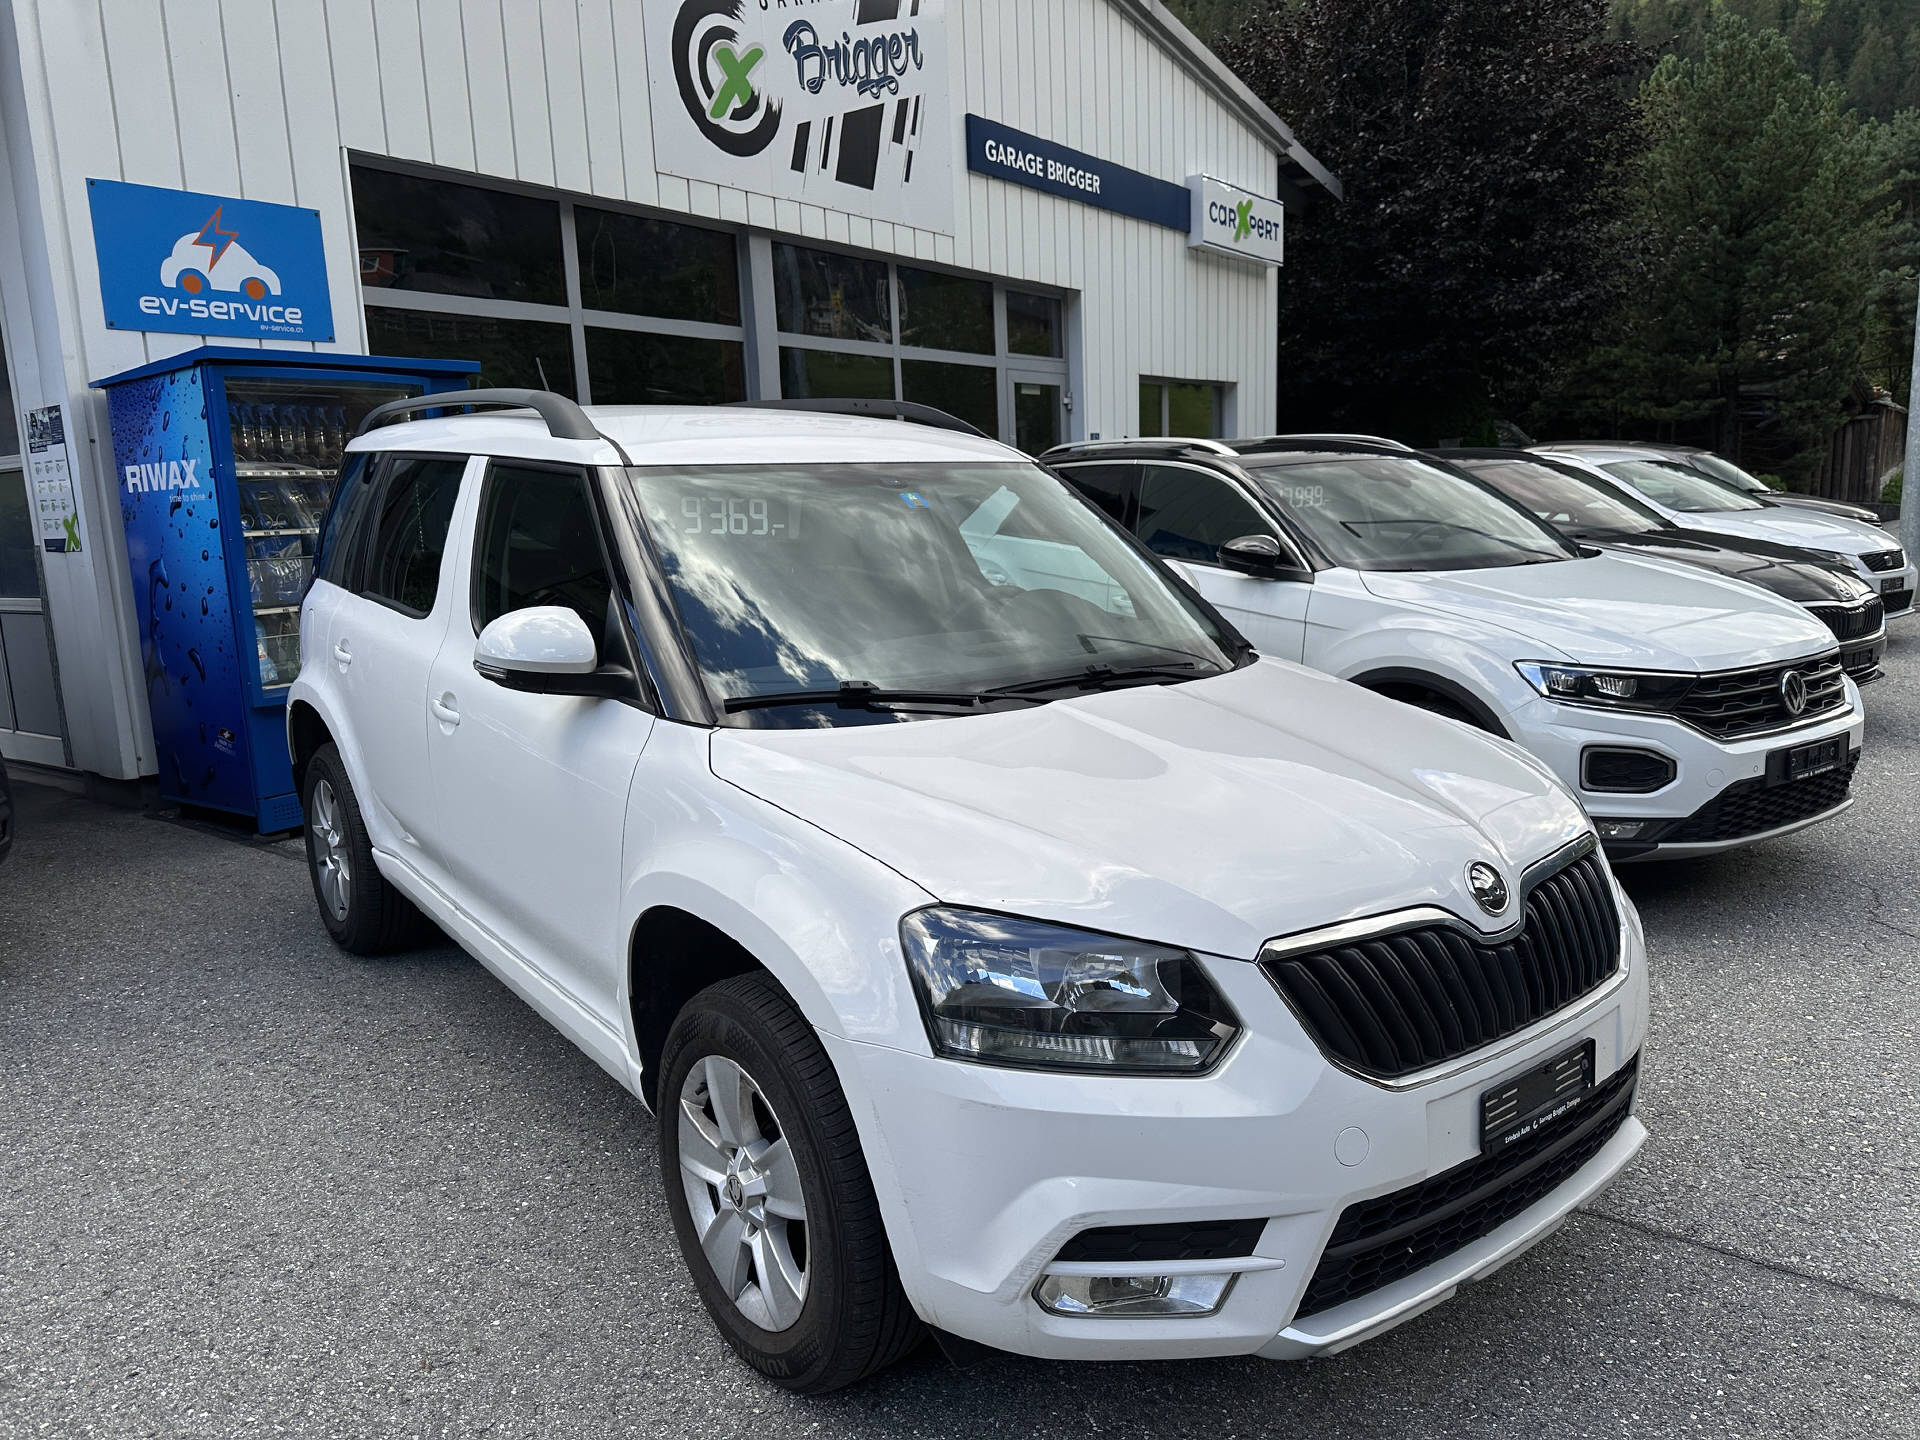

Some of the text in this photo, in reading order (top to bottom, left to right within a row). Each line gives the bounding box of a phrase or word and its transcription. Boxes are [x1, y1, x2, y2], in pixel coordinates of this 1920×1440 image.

[783, 19, 923, 98] Brigger
[985, 139, 1101, 194] GARAGE BRIGGER
[139, 296, 303, 325] ev-service
[260, 324, 304, 333] ev-service.ch
[125, 460, 199, 493] RIWAX
